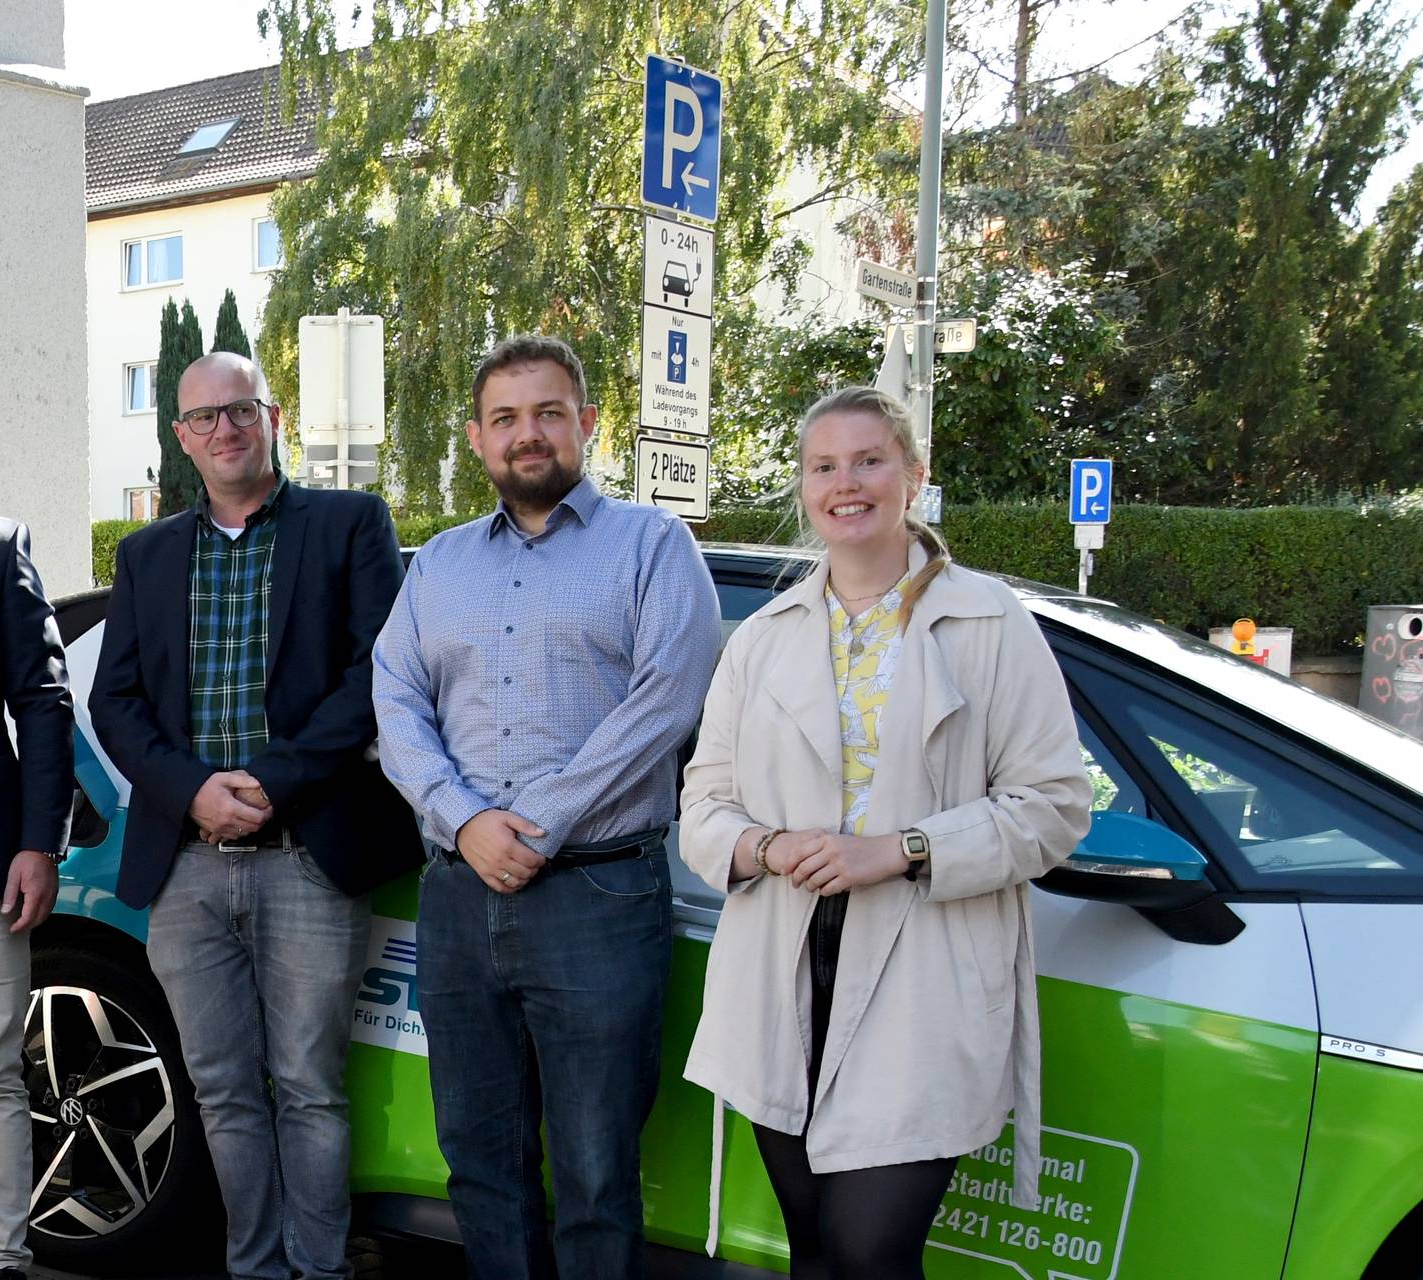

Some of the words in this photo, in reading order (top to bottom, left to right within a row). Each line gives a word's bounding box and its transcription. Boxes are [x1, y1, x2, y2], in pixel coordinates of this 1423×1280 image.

[662, 80, 703, 189] P
[862, 268, 913, 298] Gartenstraße
[672, 316, 684, 327] Nur
[651, 351, 662, 360] mit
[692, 357, 699, 367] 4h
[655, 384, 684, 398] Während
[685, 390, 697, 400] des
[653, 400, 698, 418] Ladevorgangs
[651, 452, 658, 480] 2
[662, 453, 696, 484] Plätze
[1080, 468, 1102, 515] P
[354, 1009, 380, 1026] Für
[385, 1015, 425, 1036] Dich.
[1330, 1039, 1366, 1053] PRO
[1376, 1049, 1386, 1057] S
[947, 1169, 1093, 1225] Stadterke:
[997, 1220, 1102, 1265] 126-800
